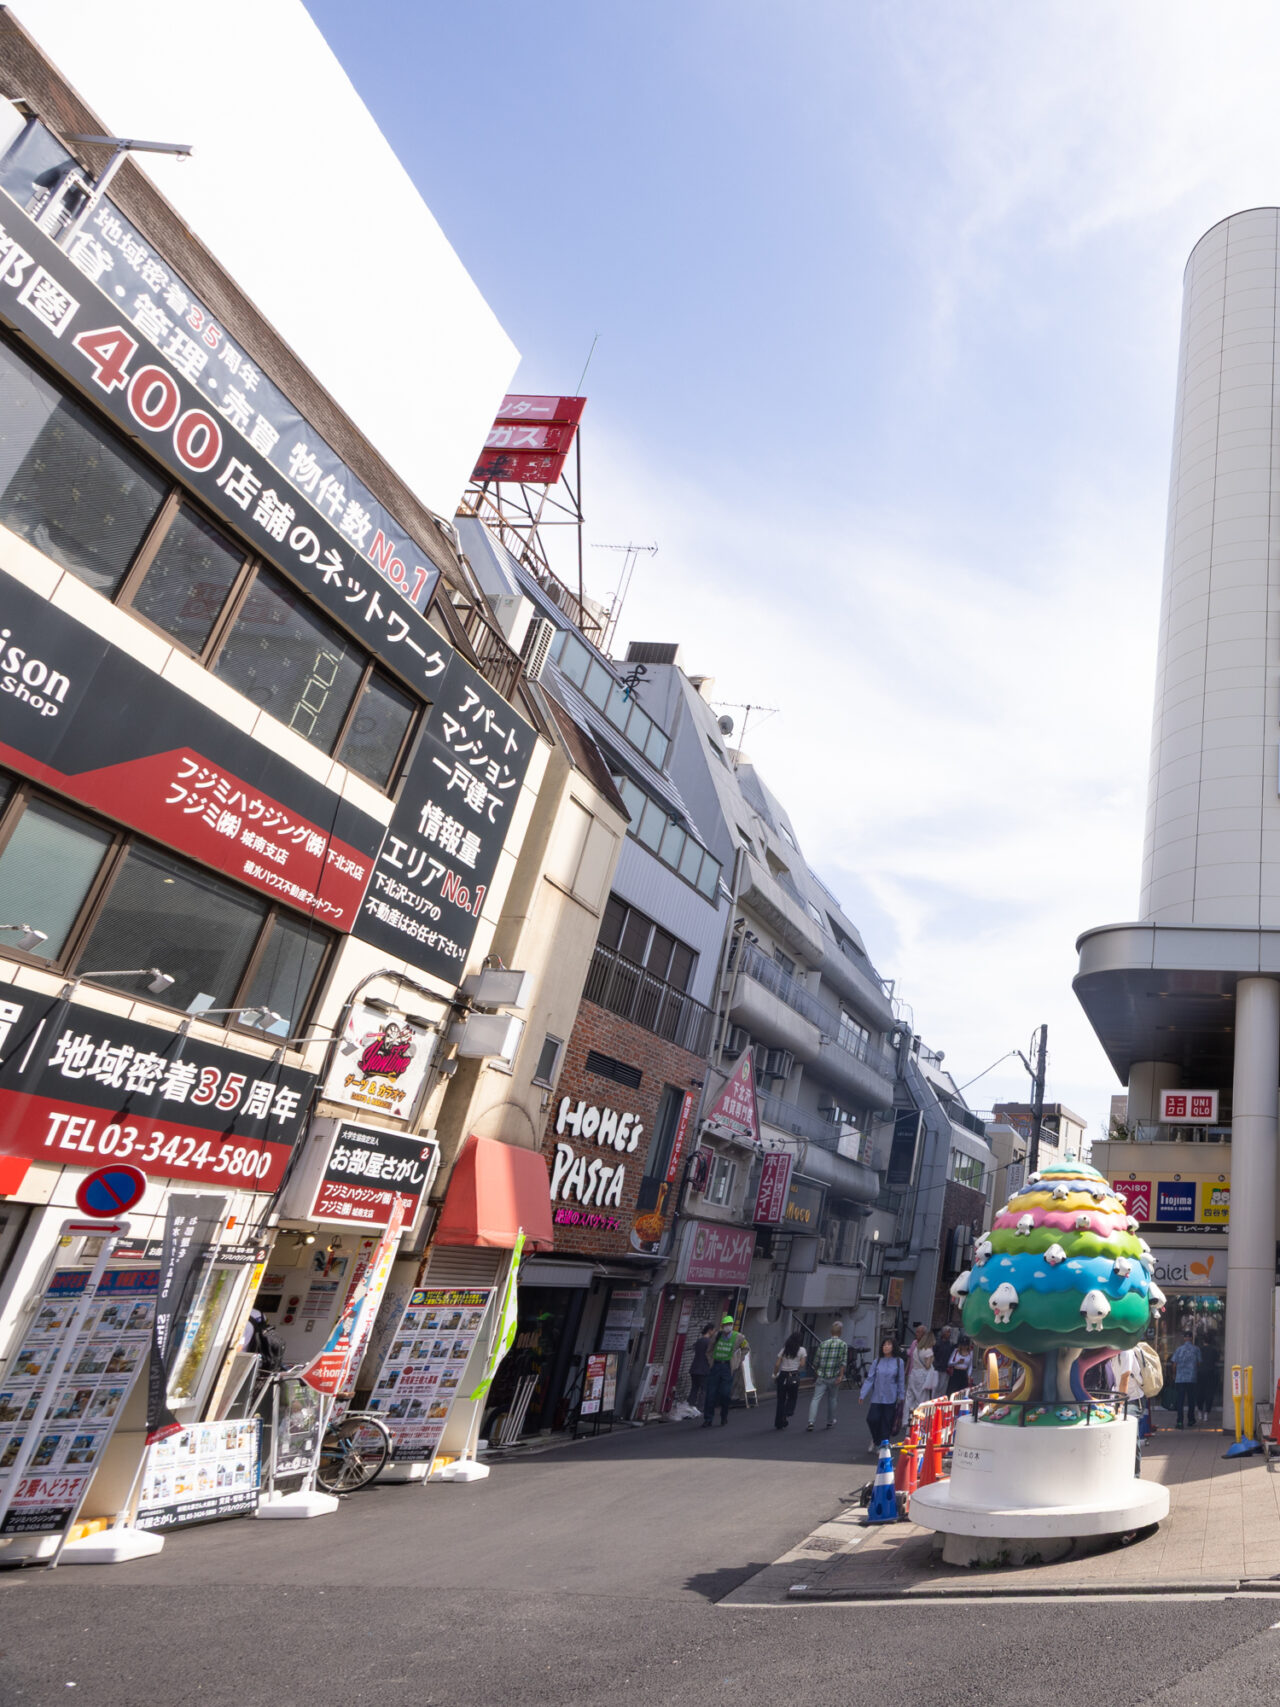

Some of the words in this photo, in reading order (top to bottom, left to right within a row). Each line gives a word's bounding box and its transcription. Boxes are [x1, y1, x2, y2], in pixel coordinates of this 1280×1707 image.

[93, 206, 260, 393] 地域密着35周年
[486, 425, 540, 447] ガス
[286, 442, 375, 548] 物件数
[367, 529, 427, 602] No.1
[0, 675, 59, 717] Shop
[463, 685, 520, 756] アパート
[441, 713, 518, 791] マンション
[431, 757, 505, 824] 一戸建て
[240, 829, 290, 866] 城南支店
[420, 800, 483, 870] 情報量
[326, 847, 365, 881] 下北沢店
[382, 836, 487, 917] エリアNo.1
[243, 859, 345, 919] 積水ハウス不動産ネットワーク
[374, 870, 442, 922] 下北沢エリアの
[48, 1029, 302, 1126] 地域密着35周年
[344, 1073, 367, 1092] ダーツ
[378, 1084, 407, 1103] カラオケ
[1193, 1097, 1209, 1107] UNI
[1193, 1107, 1210, 1116] QLO
[329, 1145, 424, 1185] お部屋さがし
[551, 1143, 625, 1207] PASTA
[1116, 1184, 1148, 1192] DAISO
[1160, 1193, 1193, 1206] nojima
[554, 1208, 622, 1231] 絶望のスパゲッティ
[1176, 1225, 1218, 1233] エレベーター
[705, 1230, 752, 1265] ホームメイト
[1151, 1265, 1188, 1281] aiei
[14, 1478, 88, 1498] 2階へどうぞ!
